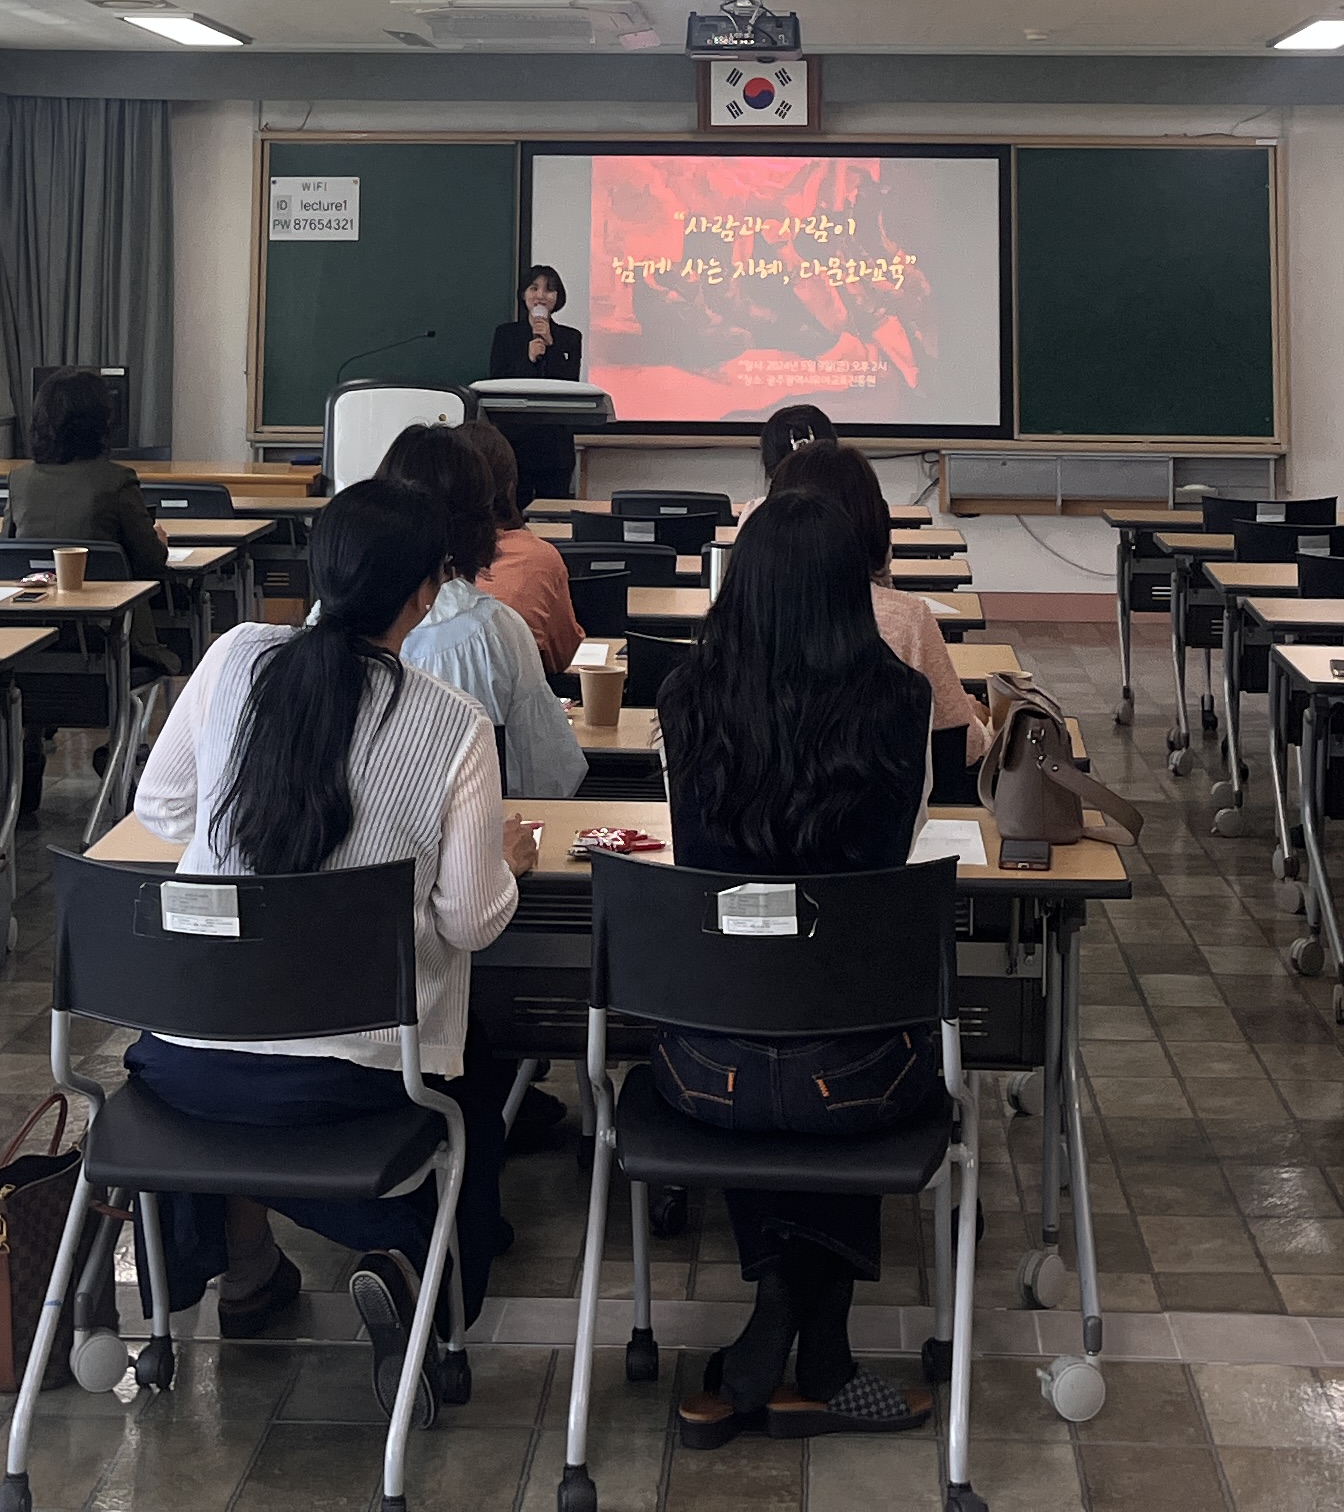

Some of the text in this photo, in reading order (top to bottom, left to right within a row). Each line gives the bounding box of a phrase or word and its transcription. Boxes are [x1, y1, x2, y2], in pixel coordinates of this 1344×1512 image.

[301, 181, 328, 192] WIFI
[276, 199, 348, 211] ID lecture1
[272, 218, 354, 231] PW 87654321
[778, 214, 856, 243] 사람이
[612, 256, 673, 284] 함께
[681, 256, 724, 285] 사는
[732, 257, 790, 286] 지혜,
